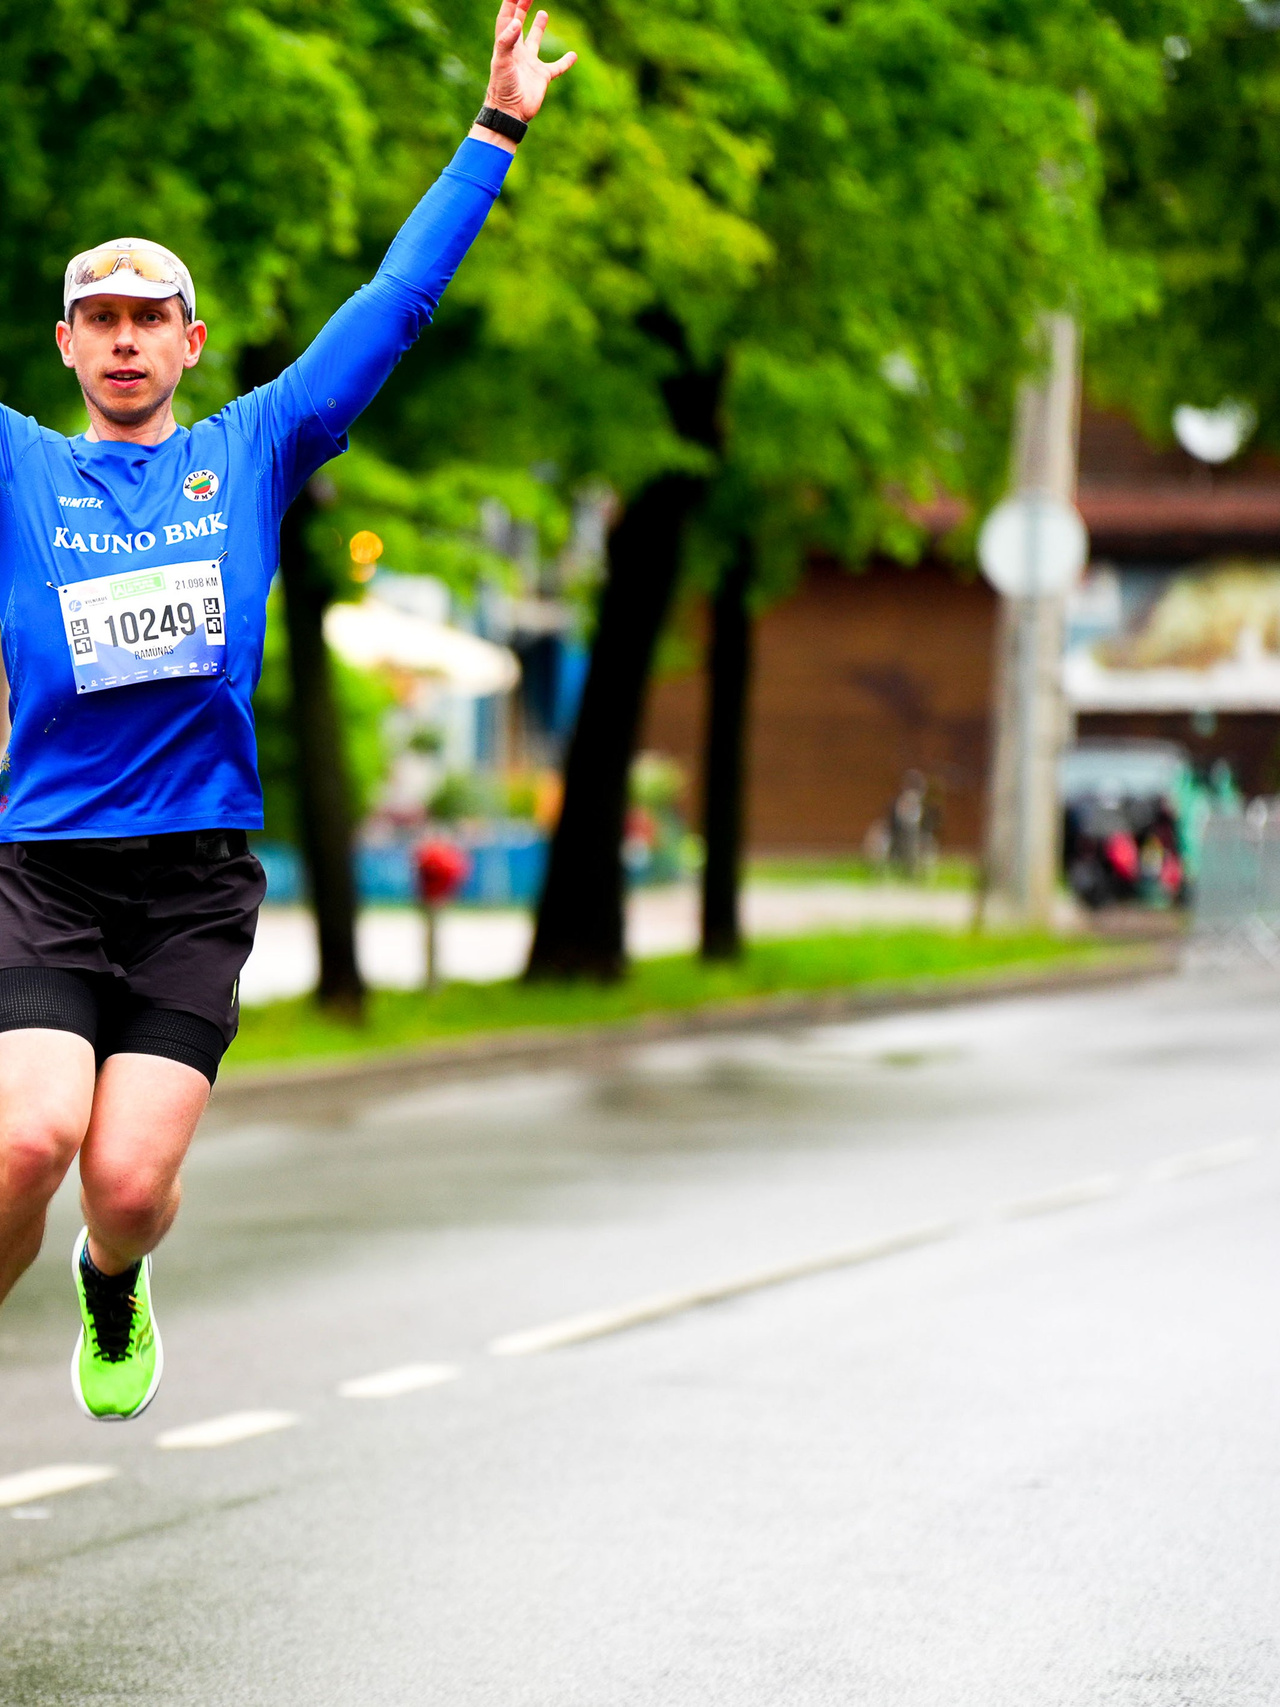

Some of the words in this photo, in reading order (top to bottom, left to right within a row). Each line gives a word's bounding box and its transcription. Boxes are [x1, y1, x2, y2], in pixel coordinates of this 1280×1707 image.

[185, 471, 214, 489] KAUNO
[194, 490, 215, 500] BMK
[53, 527, 156, 554] KAUNO
[163, 512, 228, 545] BMK
[175, 577, 204, 590] 21.098
[205, 577, 218, 587] KM
[104, 602, 196, 647] 10249
